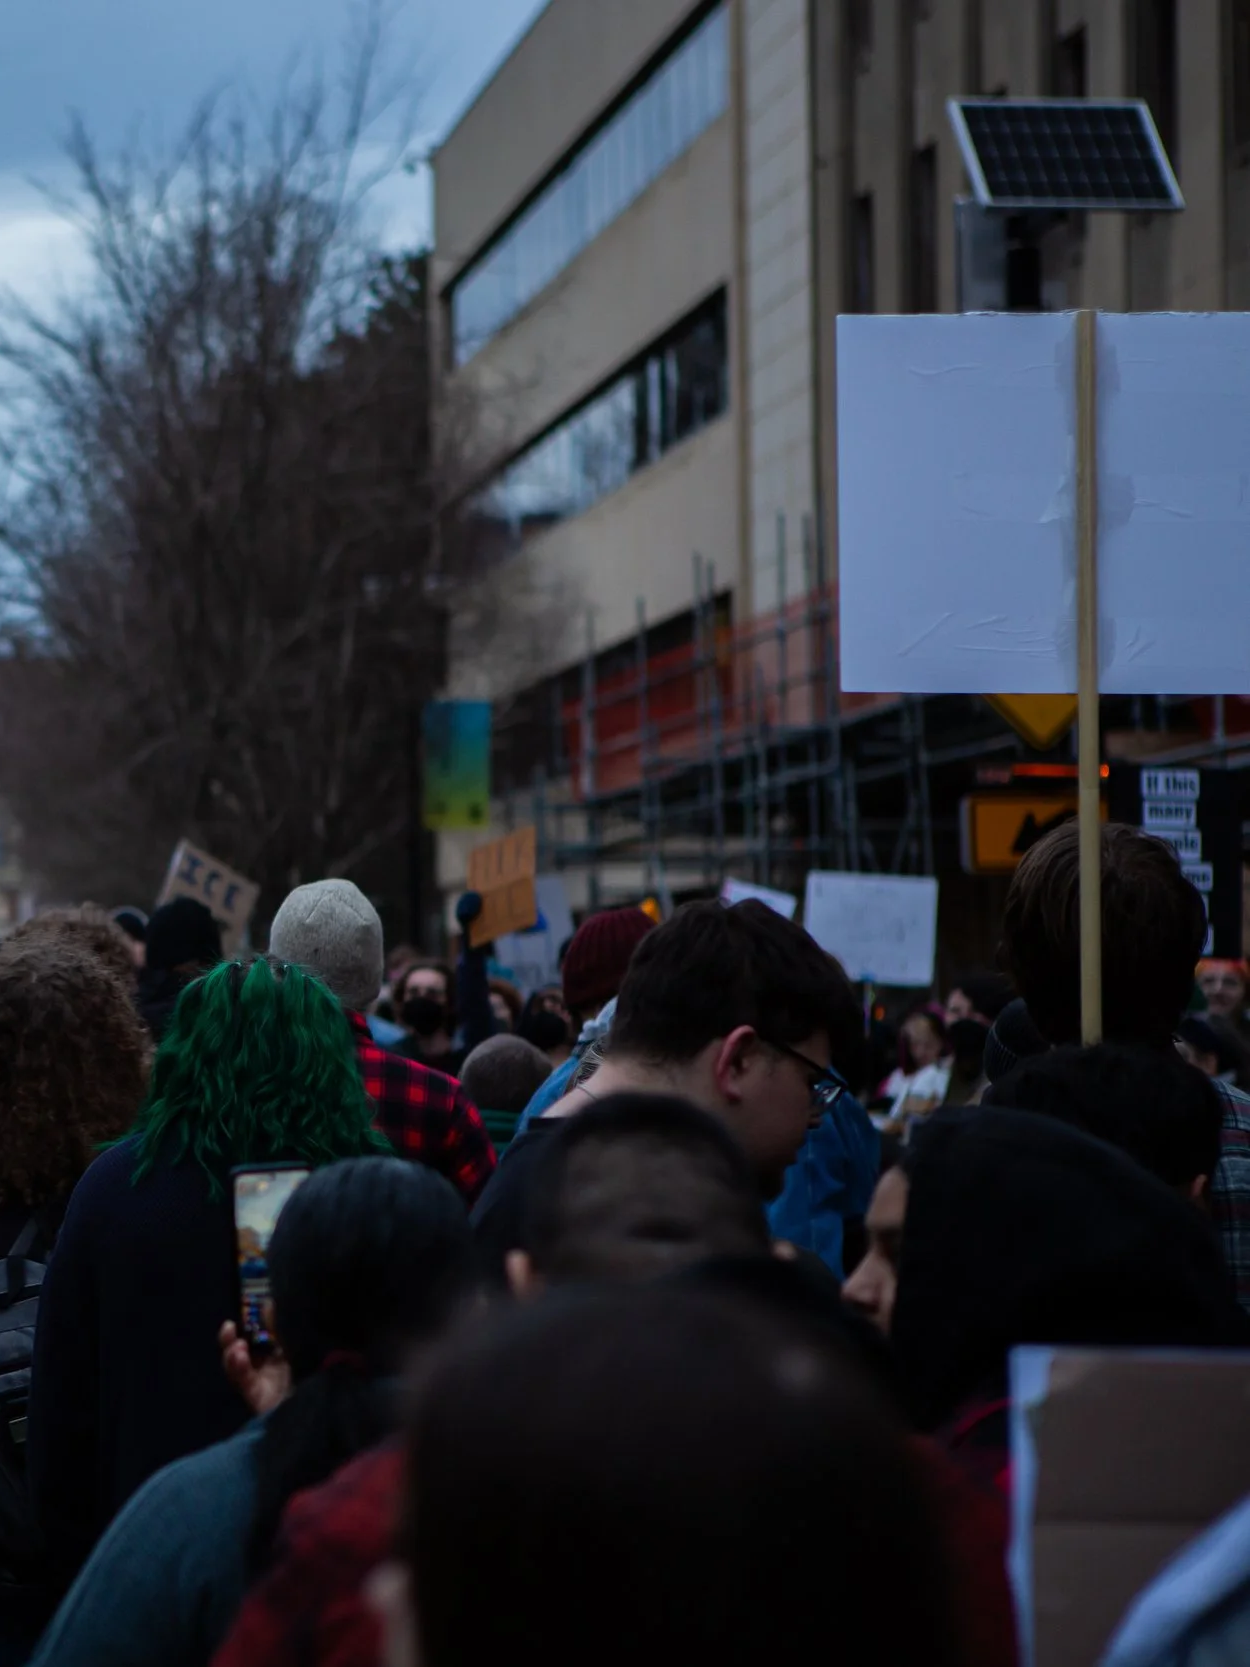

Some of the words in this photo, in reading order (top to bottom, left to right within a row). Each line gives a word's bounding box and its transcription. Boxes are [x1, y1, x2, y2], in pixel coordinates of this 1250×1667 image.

[1165, 773, 1197, 792] this
[1149, 804, 1193, 823] many
[179, 854, 243, 914] ICE
